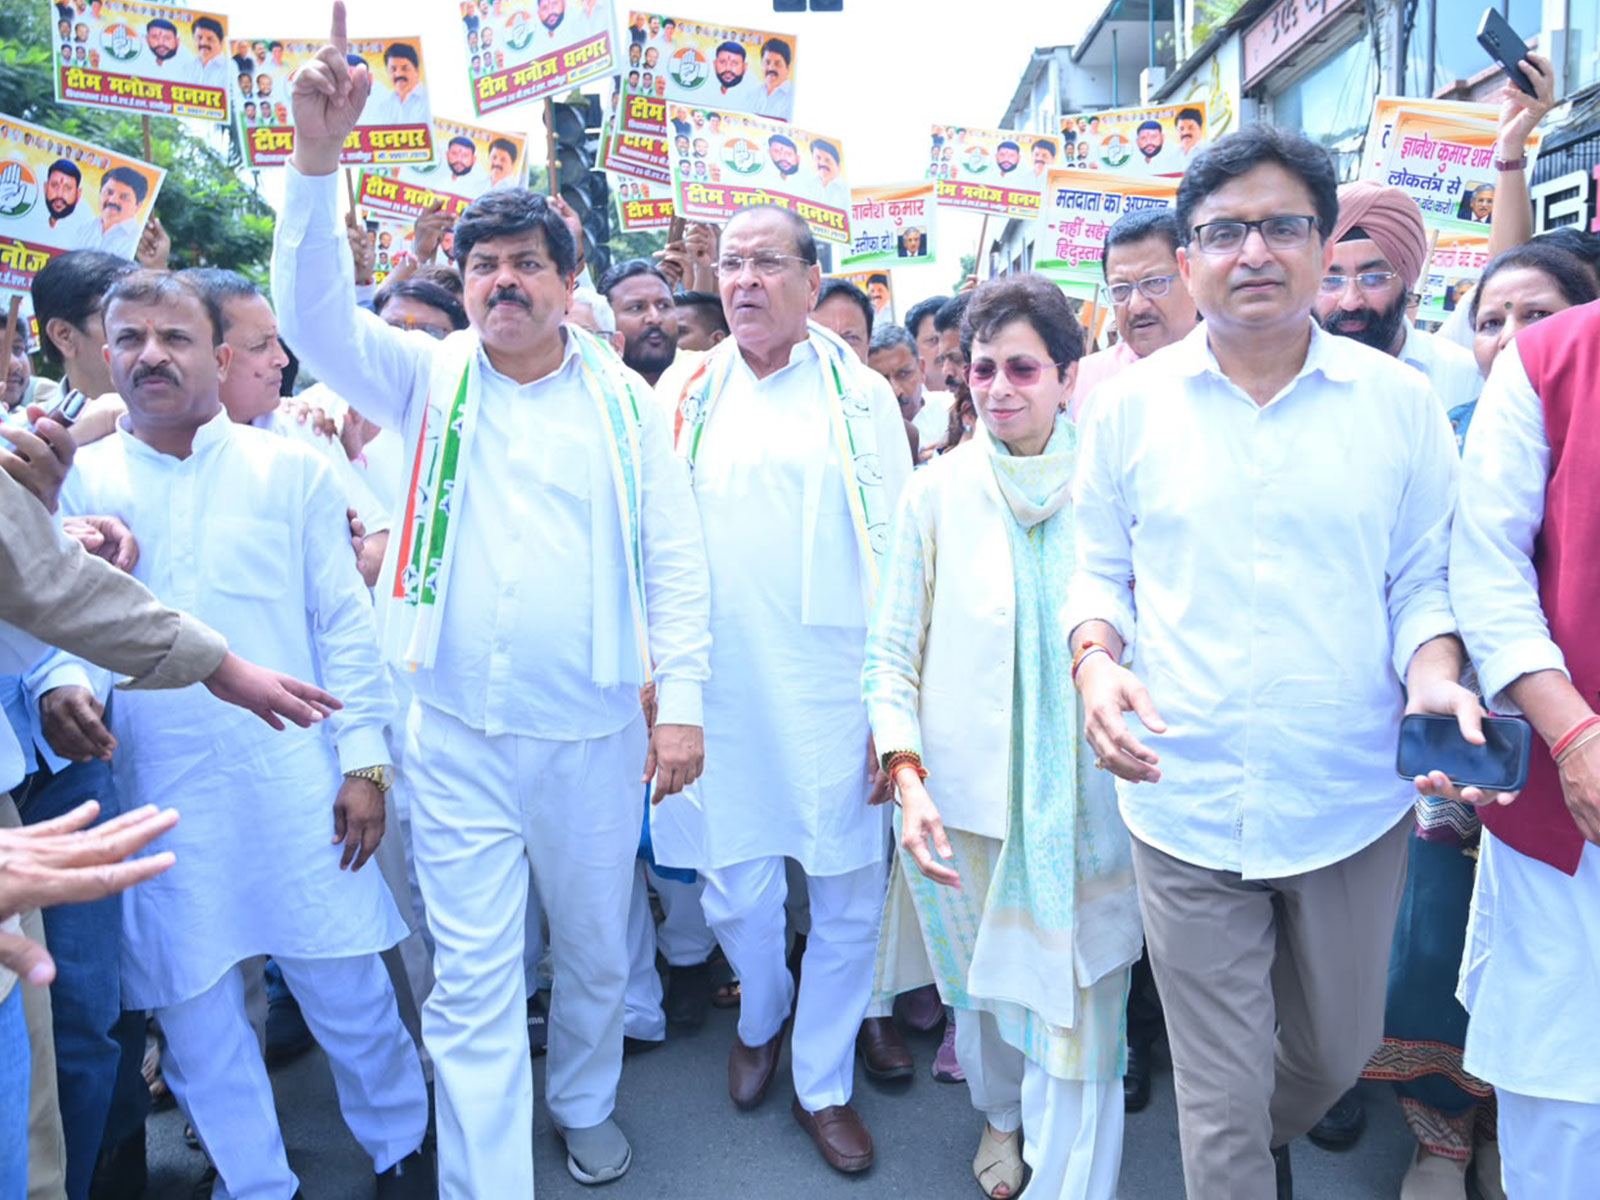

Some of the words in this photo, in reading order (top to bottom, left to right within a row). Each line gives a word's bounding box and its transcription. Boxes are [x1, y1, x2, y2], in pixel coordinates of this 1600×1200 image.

[478, 75, 509, 99] टीम
[512, 57, 559, 87] मनोज
[563, 37, 608, 68] धनगर
[66, 68, 102, 91] टीम
[107, 74, 164, 100] मनोज
[170, 85, 223, 107] धनगर
[630, 97, 666, 121] टीम
[252, 128, 293, 152] टीम
[368, 129, 427, 150] धनगर
[1401, 131, 1437, 159] ज्ञानेश
[1437, 143, 1472, 173] कुमार
[366, 175, 399, 200] टीम
[1387, 167, 1445, 192] लोकतंत्र
[1446, 176, 1462, 195] से
[685, 183, 725, 206] टीम
[796, 201, 846, 229] धनगर
[962, 185, 1004, 204] मनोज
[1056, 189, 1102, 211] मतदाता
[1104, 194, 1121, 213] का
[626, 202, 655, 219] टीम
[887, 199, 925, 226] कुमार
[1059, 216, 1085, 238] नहीं
